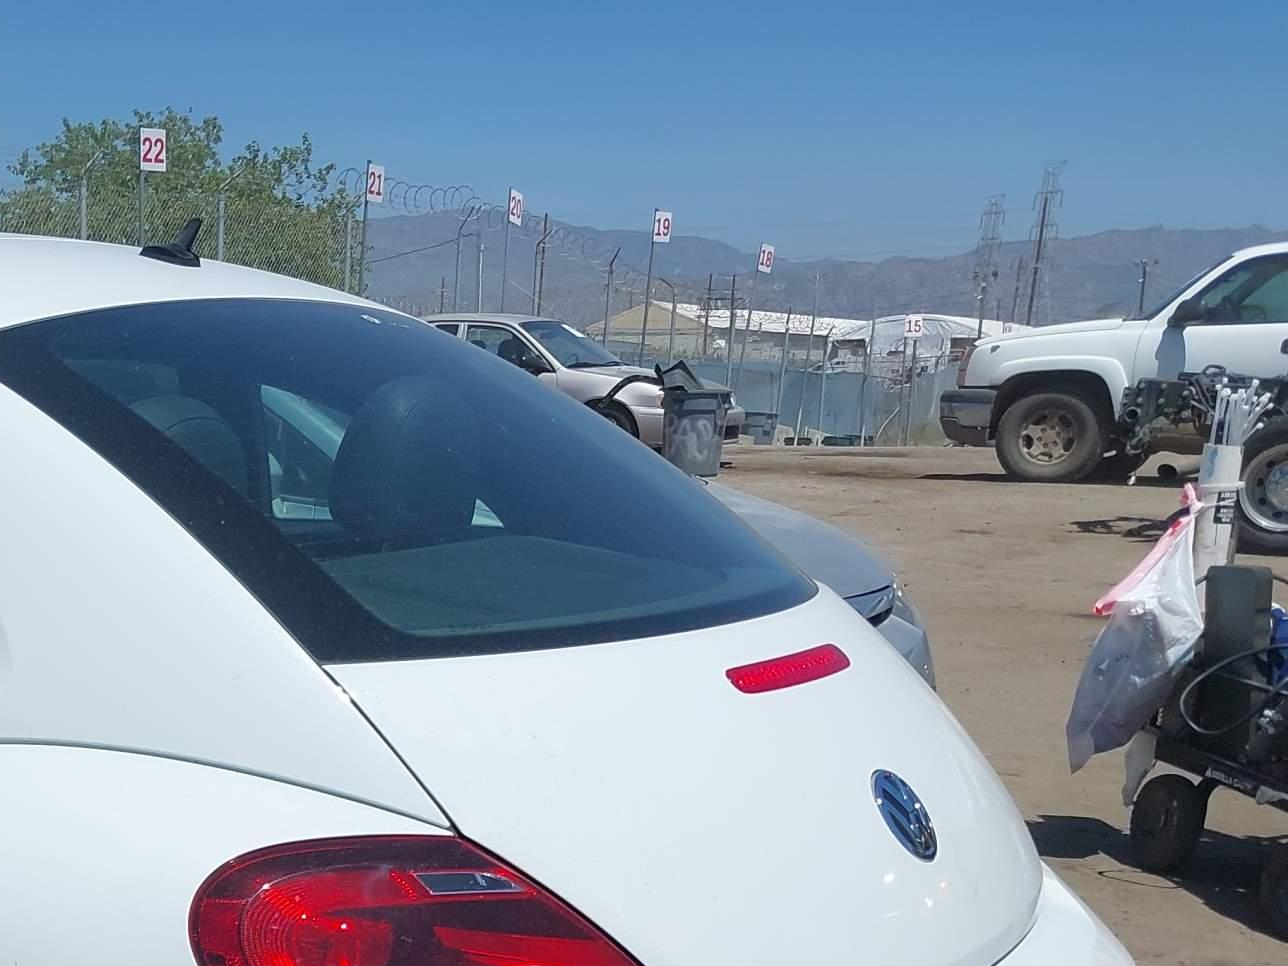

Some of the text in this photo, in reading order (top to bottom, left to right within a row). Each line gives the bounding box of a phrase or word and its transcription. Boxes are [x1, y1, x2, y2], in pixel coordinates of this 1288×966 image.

[141, 136, 165, 165] 22
[368, 171, 383, 197] 21
[510, 195, 522, 219] 20
[654, 217, 671, 238] 19
[759, 248, 774, 269] 18
[905, 318, 922, 334] 15
